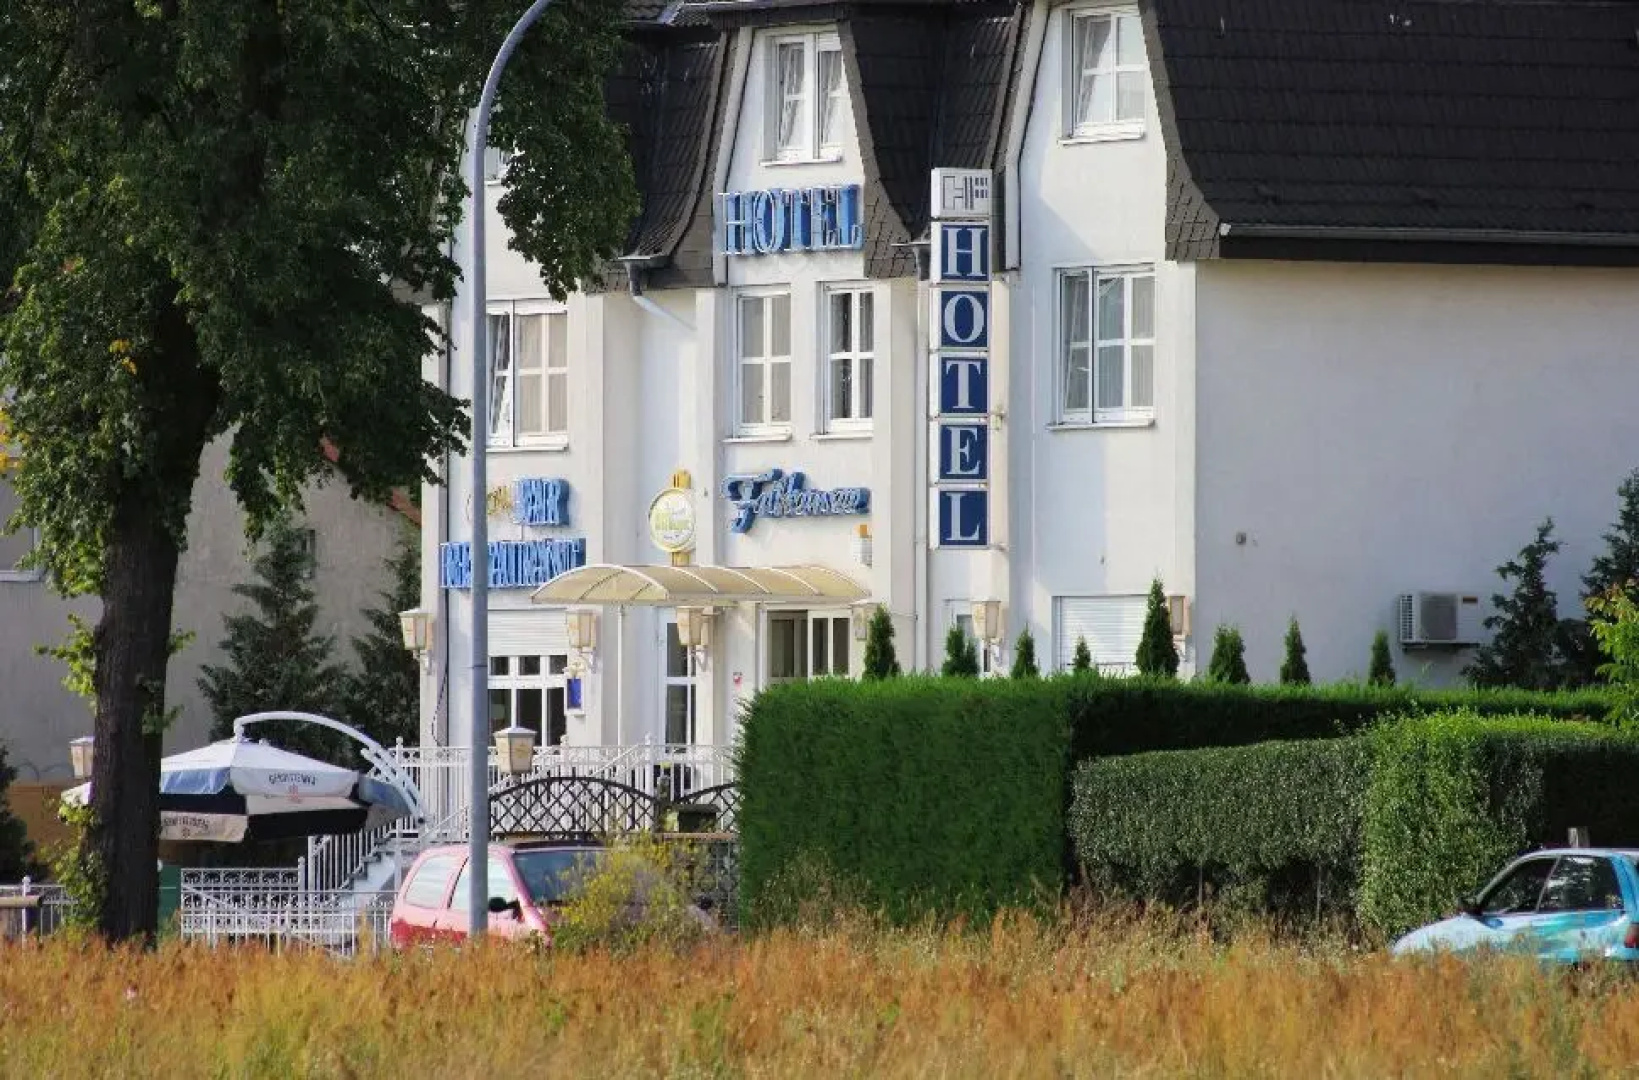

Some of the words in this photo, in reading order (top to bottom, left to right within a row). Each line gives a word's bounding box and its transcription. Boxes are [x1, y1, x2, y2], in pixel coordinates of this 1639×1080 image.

[718, 184, 863, 255] HOTEL
[942, 227, 988, 541] HOTEL
[440, 538, 586, 588] REAURANT
